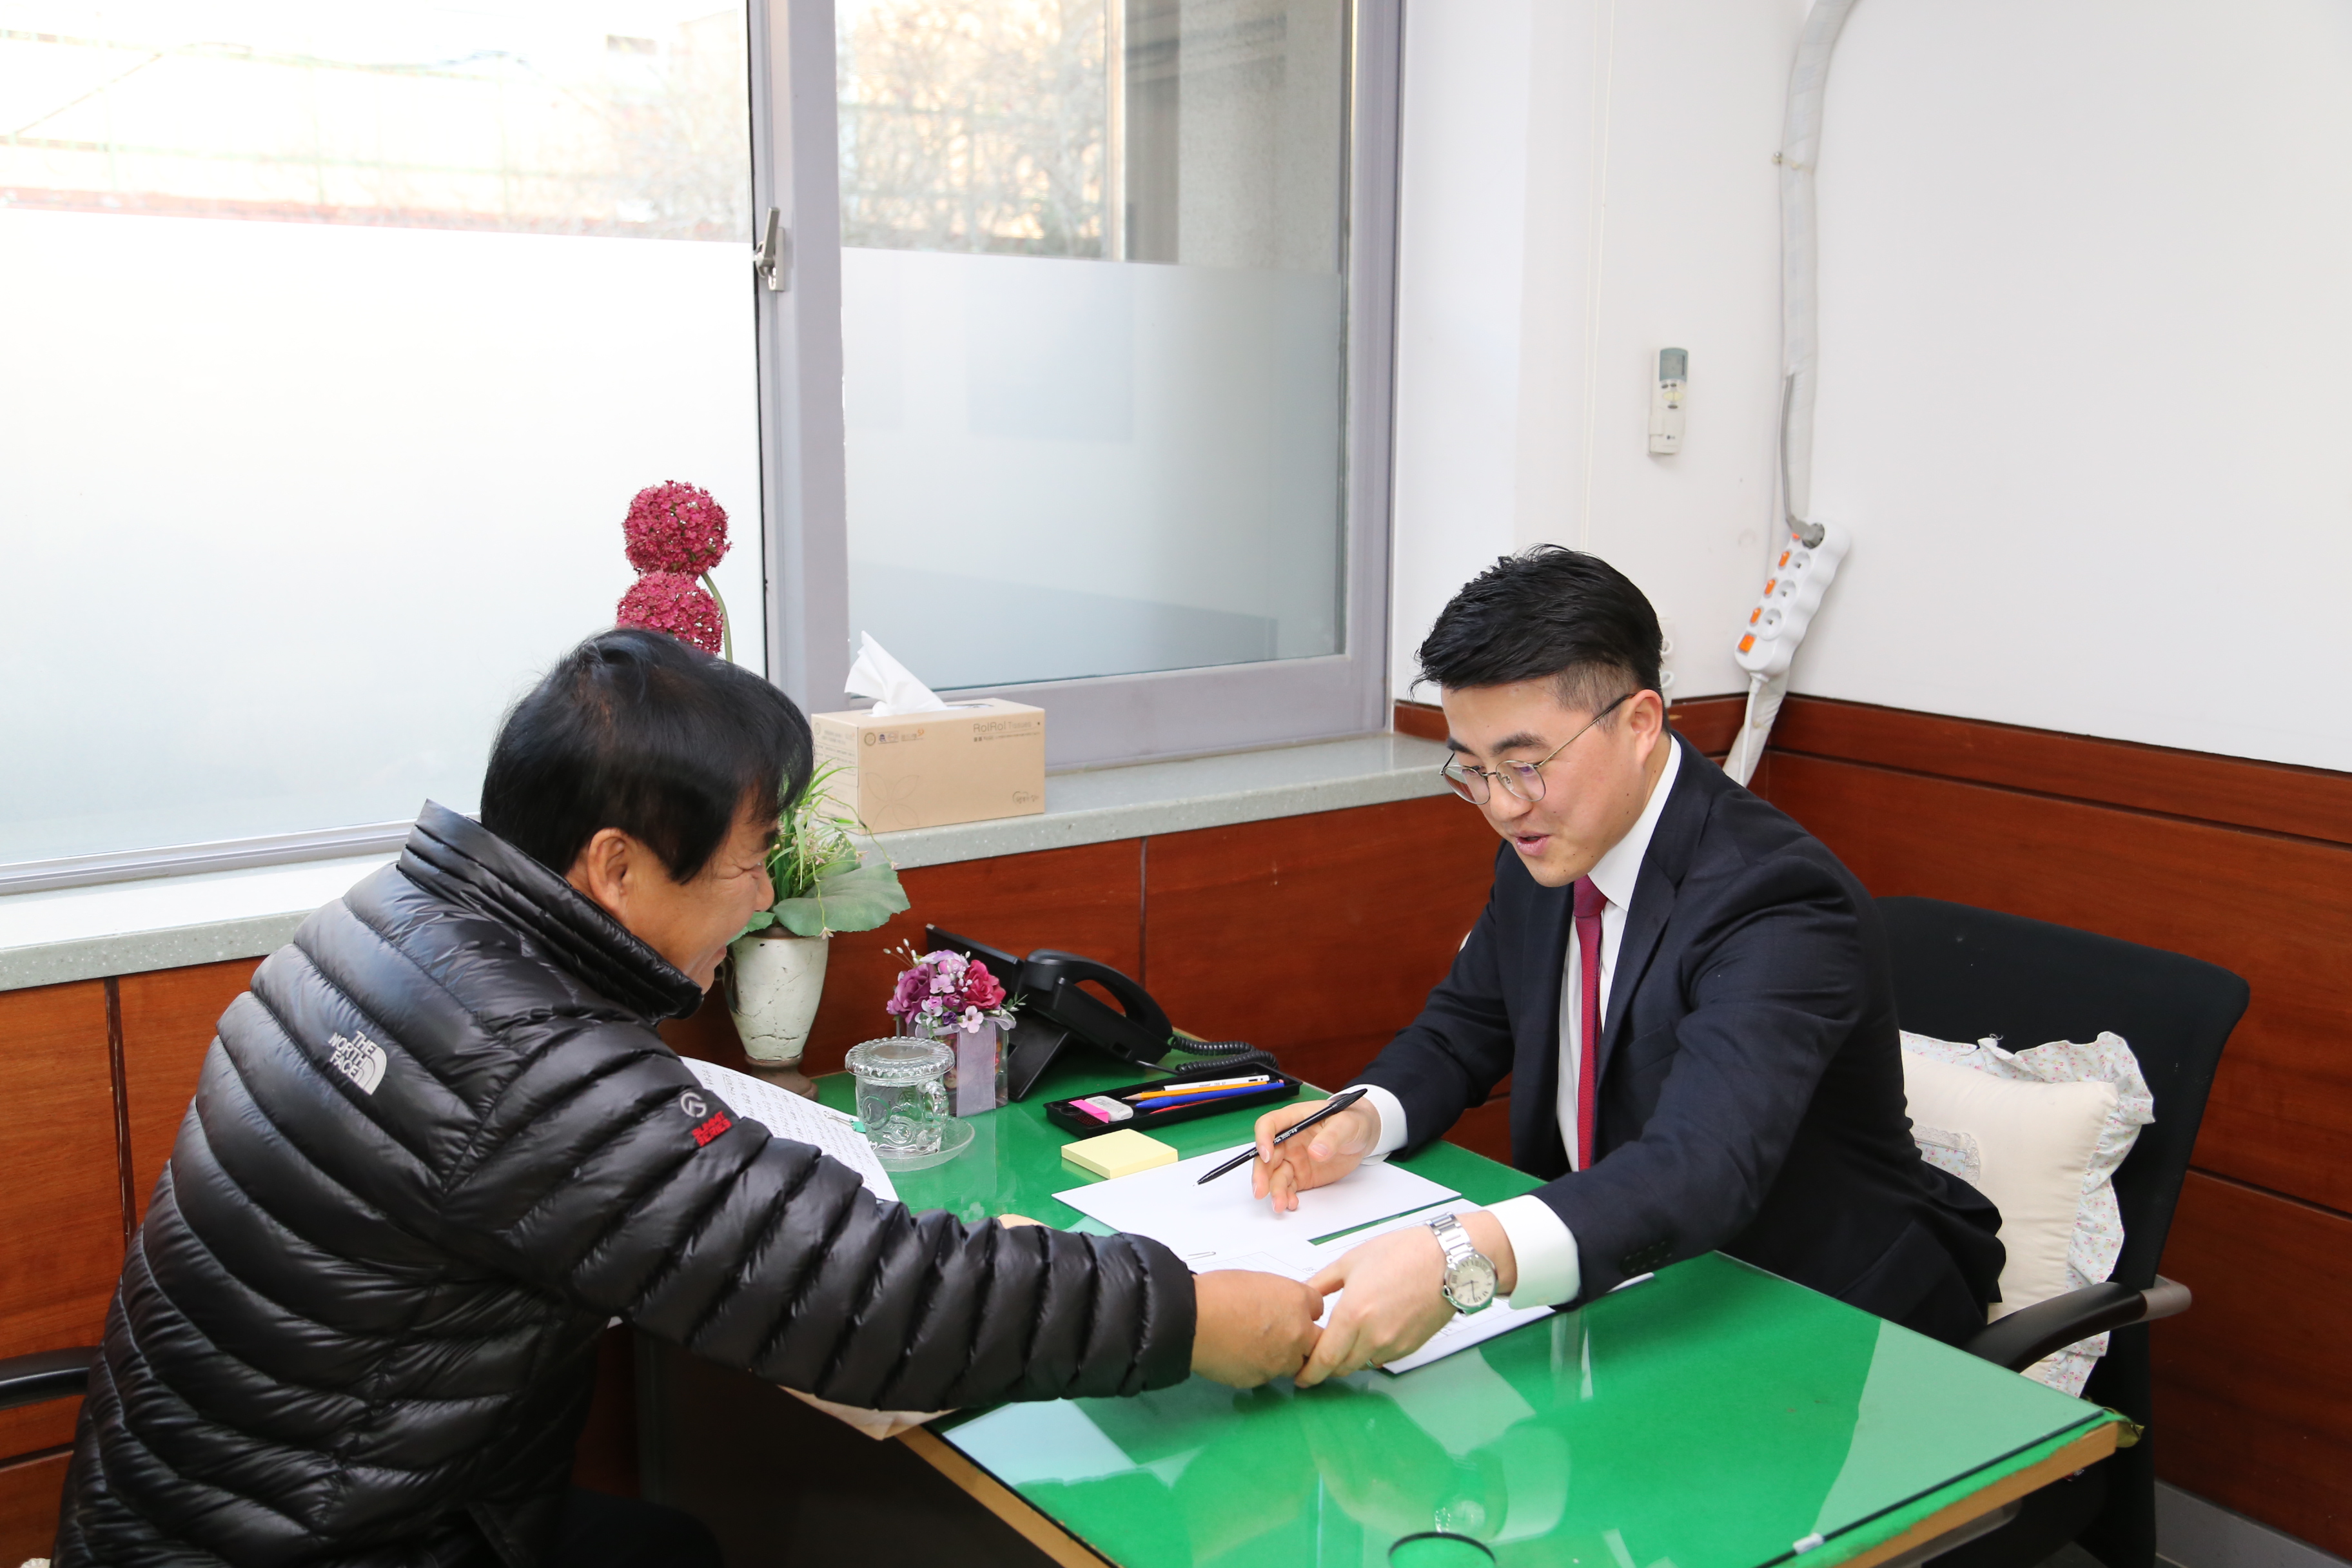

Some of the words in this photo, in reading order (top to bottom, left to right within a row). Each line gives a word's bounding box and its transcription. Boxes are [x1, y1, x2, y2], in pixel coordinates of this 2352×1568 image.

[328, 1032, 368, 1068] NORTH
[351, 1030, 378, 1055] THE
[329, 1050, 360, 1079] FACE
[696, 1118, 732, 1147] SERIES
